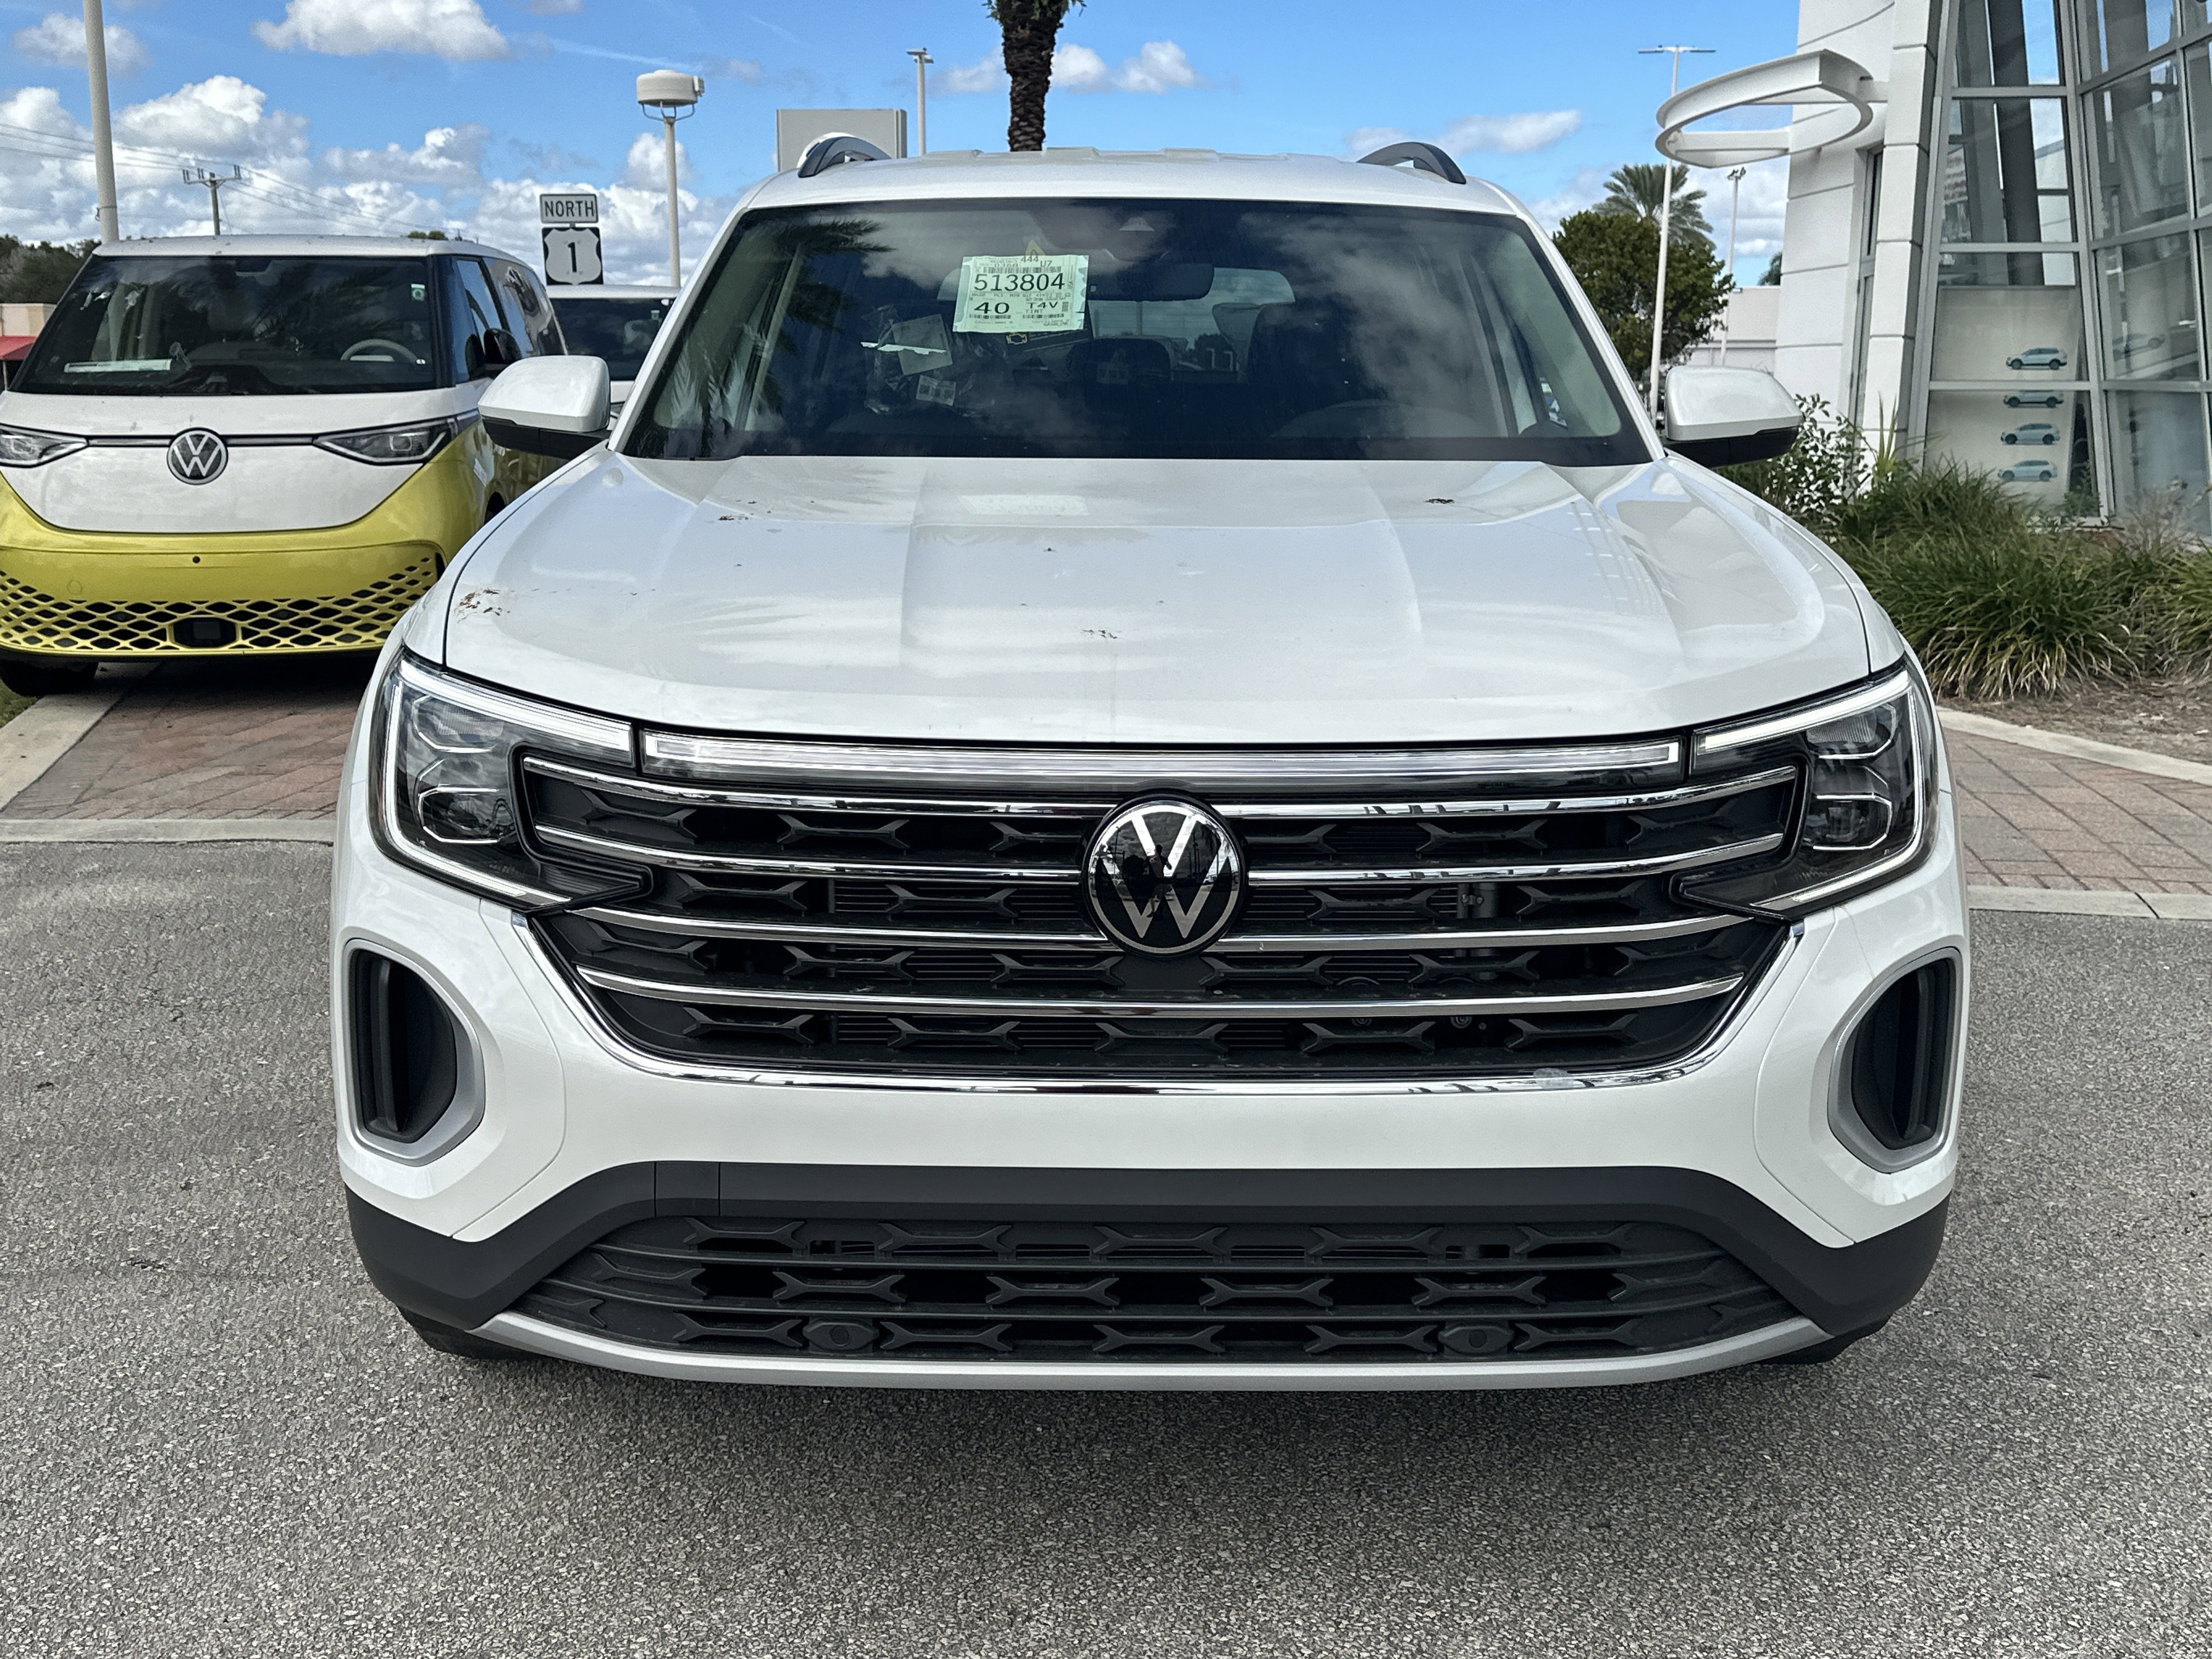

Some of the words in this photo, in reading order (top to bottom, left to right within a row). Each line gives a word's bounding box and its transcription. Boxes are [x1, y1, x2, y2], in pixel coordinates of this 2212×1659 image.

[544, 200, 595, 217] NORTH
[567, 241, 577, 273] 1
[974, 272, 1065, 291] 513804
[974, 302, 1010, 314] 40
[170, 431, 224, 481] VW
[1092, 803, 1238, 945] VW
